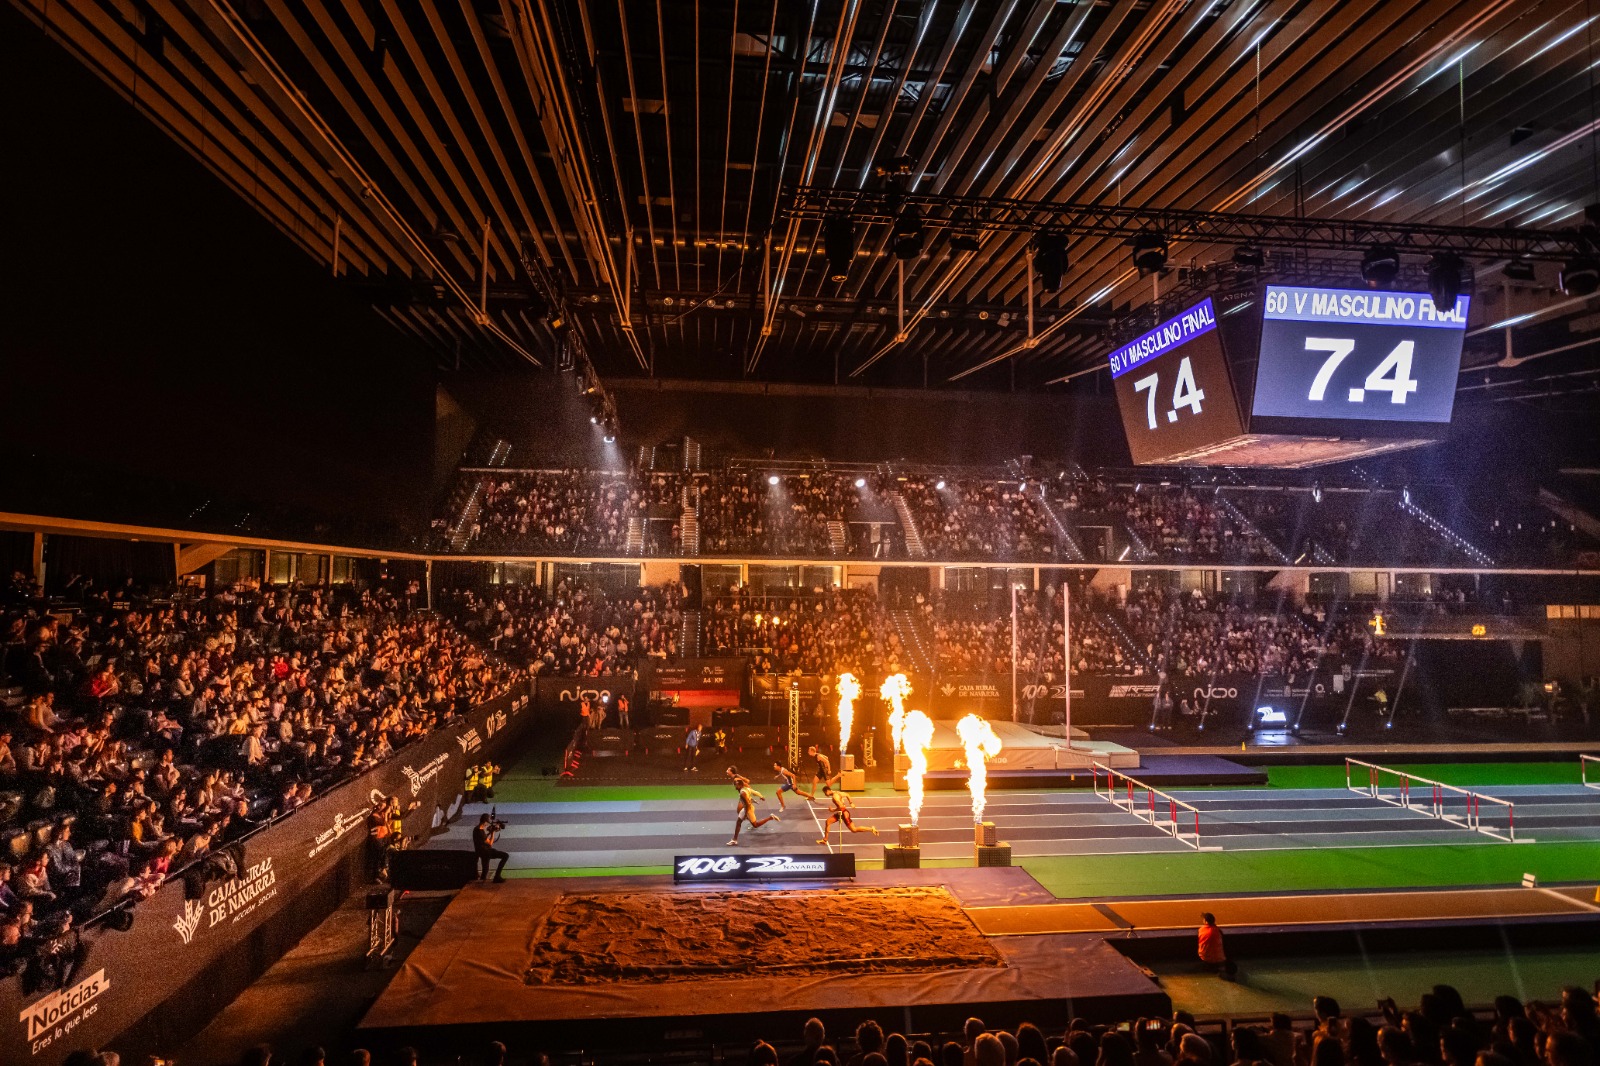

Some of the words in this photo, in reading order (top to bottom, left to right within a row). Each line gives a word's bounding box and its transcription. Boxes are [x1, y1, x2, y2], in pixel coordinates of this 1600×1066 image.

[1266, 291, 1288, 314] 60
[1294, 292, 1308, 315] V
[1311, 293, 1415, 320] MASCULINO
[1418, 299, 1467, 323] FINAL
[1110, 355, 1121, 374] 60
[1121, 350, 1128, 367] V
[1128, 321, 1181, 364] MASCULINO
[1181, 305, 1215, 337] FINAL
[1134, 356, 1205, 430] 7.4
[1305, 337, 1417, 404] 7.4
[208, 879, 237, 908] CAJA
[209, 903, 227, 928] DE
[228, 870, 276, 915] NAVARRA
[32, 980, 99, 1036] Noticias
[32, 1035, 52, 1056] Eres
[54, 1027, 63, 1040] lo
[64, 1015, 80, 1034] que
[82, 1003, 98, 1020] lees
